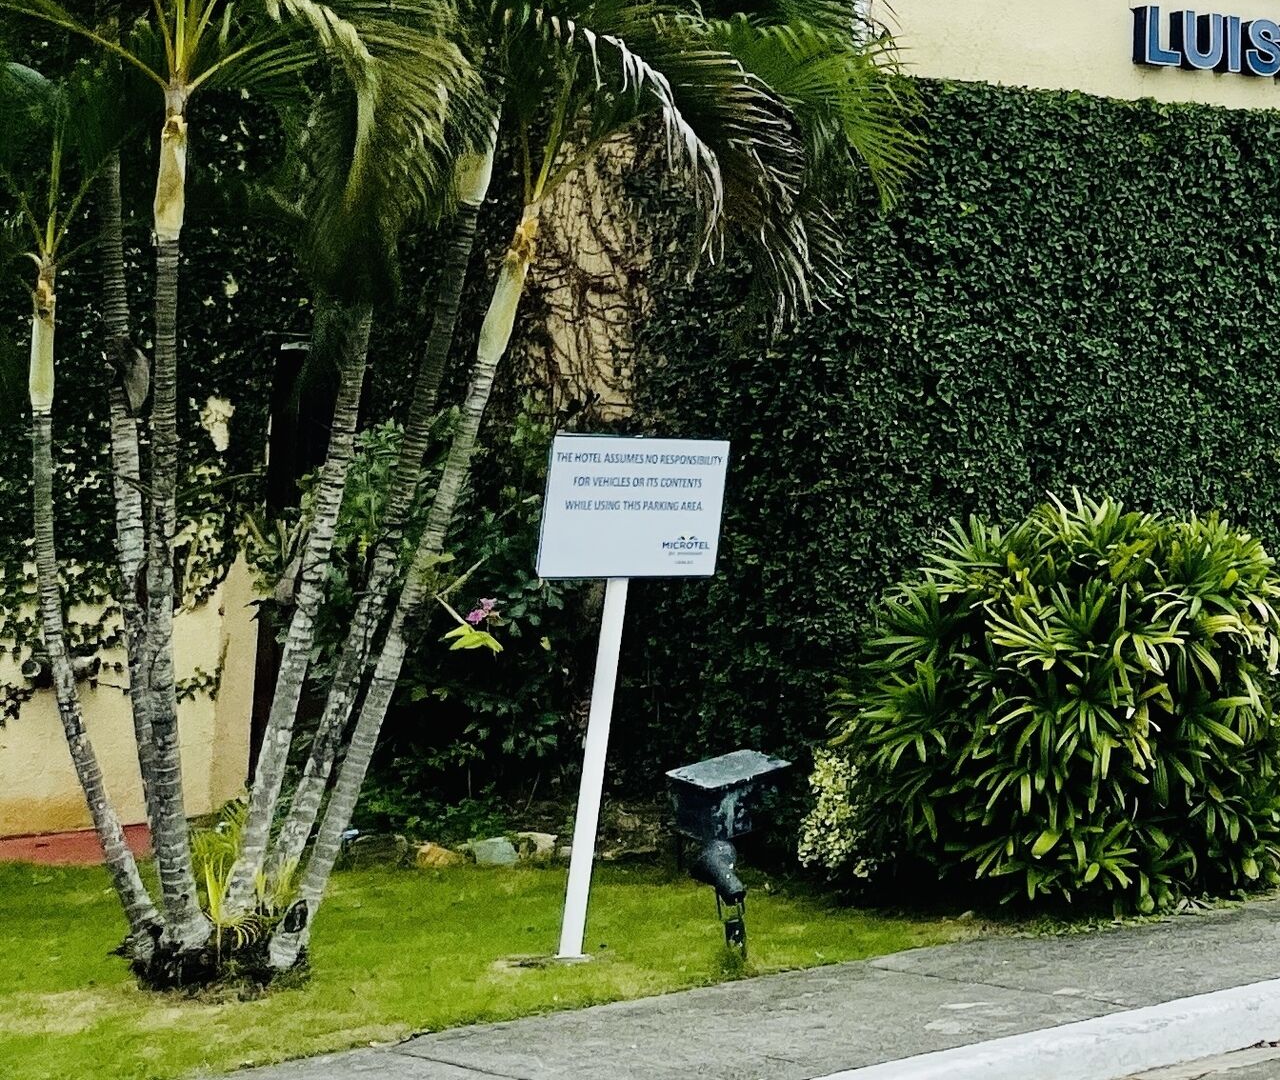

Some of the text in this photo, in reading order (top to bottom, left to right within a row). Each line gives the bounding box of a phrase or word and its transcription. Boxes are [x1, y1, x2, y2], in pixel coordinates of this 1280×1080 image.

[557, 452, 723, 466] THE HOTEL ASSUMES NO RESPONSIBILITY
[573, 476, 702, 489] FOR VEHICLES OR ITS CONTENTS
[565, 499, 592, 511] WHILE
[594, 500, 621, 511] USING
[623, 500, 641, 511] THIS
[642, 501, 679, 512] PARKING
[662, 541, 710, 550] MICROTEL
